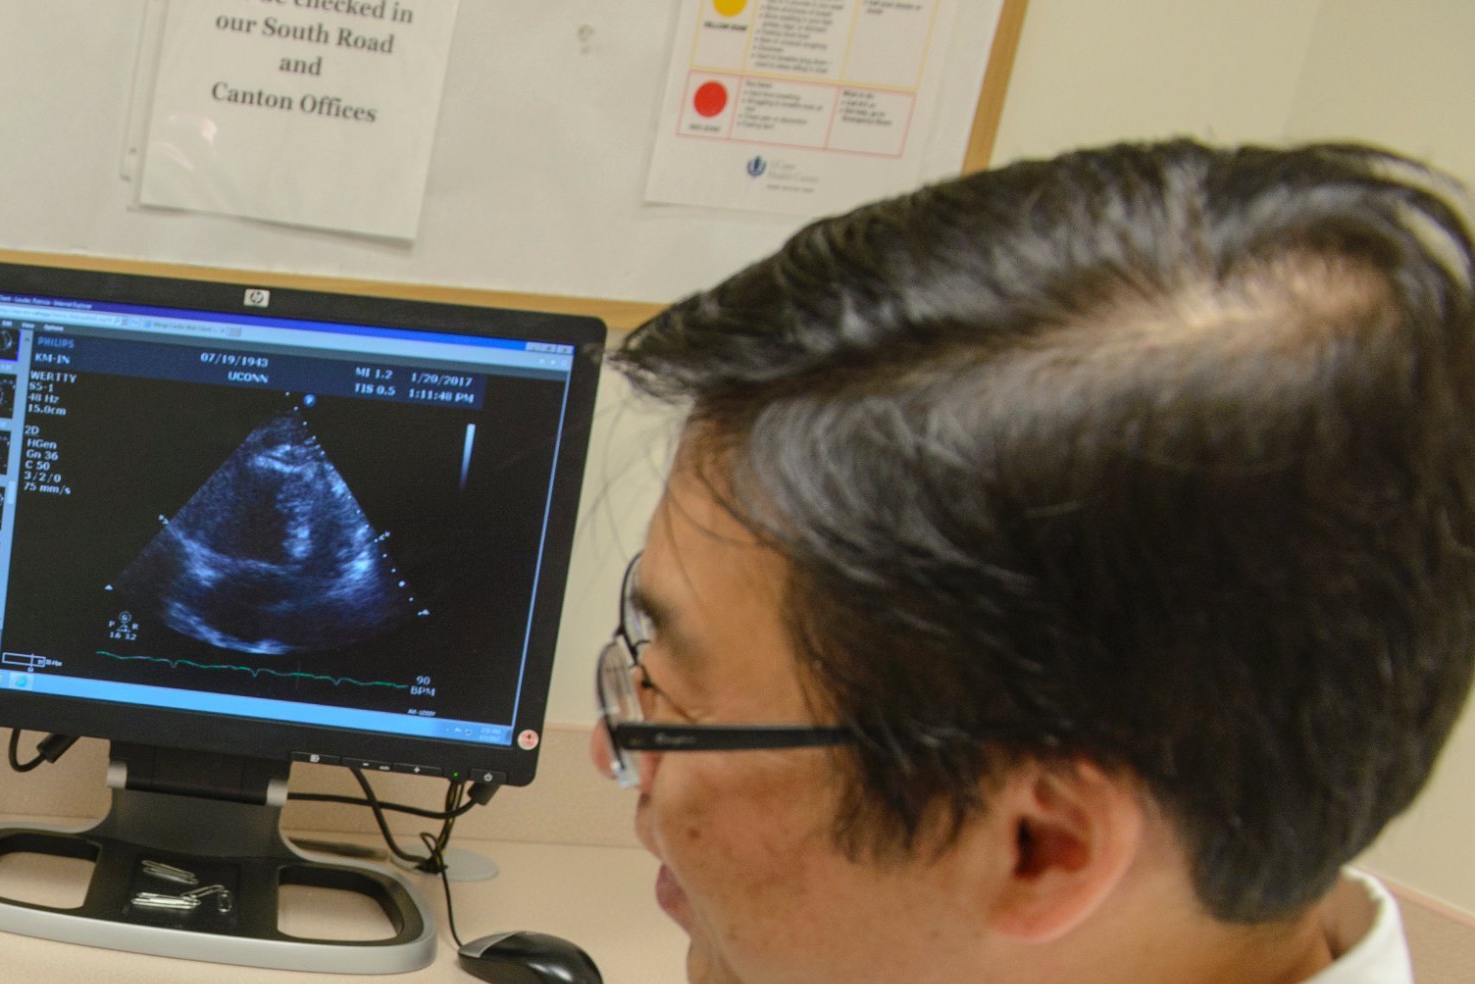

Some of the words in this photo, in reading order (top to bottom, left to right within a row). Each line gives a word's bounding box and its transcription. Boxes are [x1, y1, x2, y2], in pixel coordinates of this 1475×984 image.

[391, 8, 413, 23] in
[215, 14, 257, 33] our
[262, 17, 330, 43] South
[336, 27, 395, 54] Road
[279, 56, 323, 76] and
[211, 81, 293, 110] Canton
[300, 95, 376, 122] Offices
[37, 336, 74, 348] PHILIPS
[35, 352, 70, 364] KM-IN
[200, 352, 269, 368] 07/19/1943
[30, 370, 77, 383] WERTTY
[228, 371, 269, 384] UCONN
[355, 366, 371, 378] MI
[375, 368, 393, 380] 1.2
[410, 372, 473, 387] 1/20/2017
[29, 382, 54, 392] S5-1
[354, 383, 374, 394] TIS
[376, 384, 396, 396] 0.5
[28, 394, 42, 402] 48
[44, 394, 60, 404] Hz
[409, 388, 452, 401] 1:11:48
[455, 391, 474, 404] PM
[28, 404, 66, 416] 15.0cm
[25, 425, 40, 435] 2D
[27, 438, 57, 449] HGen
[26, 449, 42, 459] Gn
[45, 451, 58, 461] 36
[25, 460, 33, 469] C
[36, 461, 50, 471] 50
[24, 471, 61, 483] 3/2/0
[24, 482, 36, 492] 75
[39, 484, 71, 495] mm/s
[416, 675, 431, 685] 90
[410, 686, 436, 697] BPM
